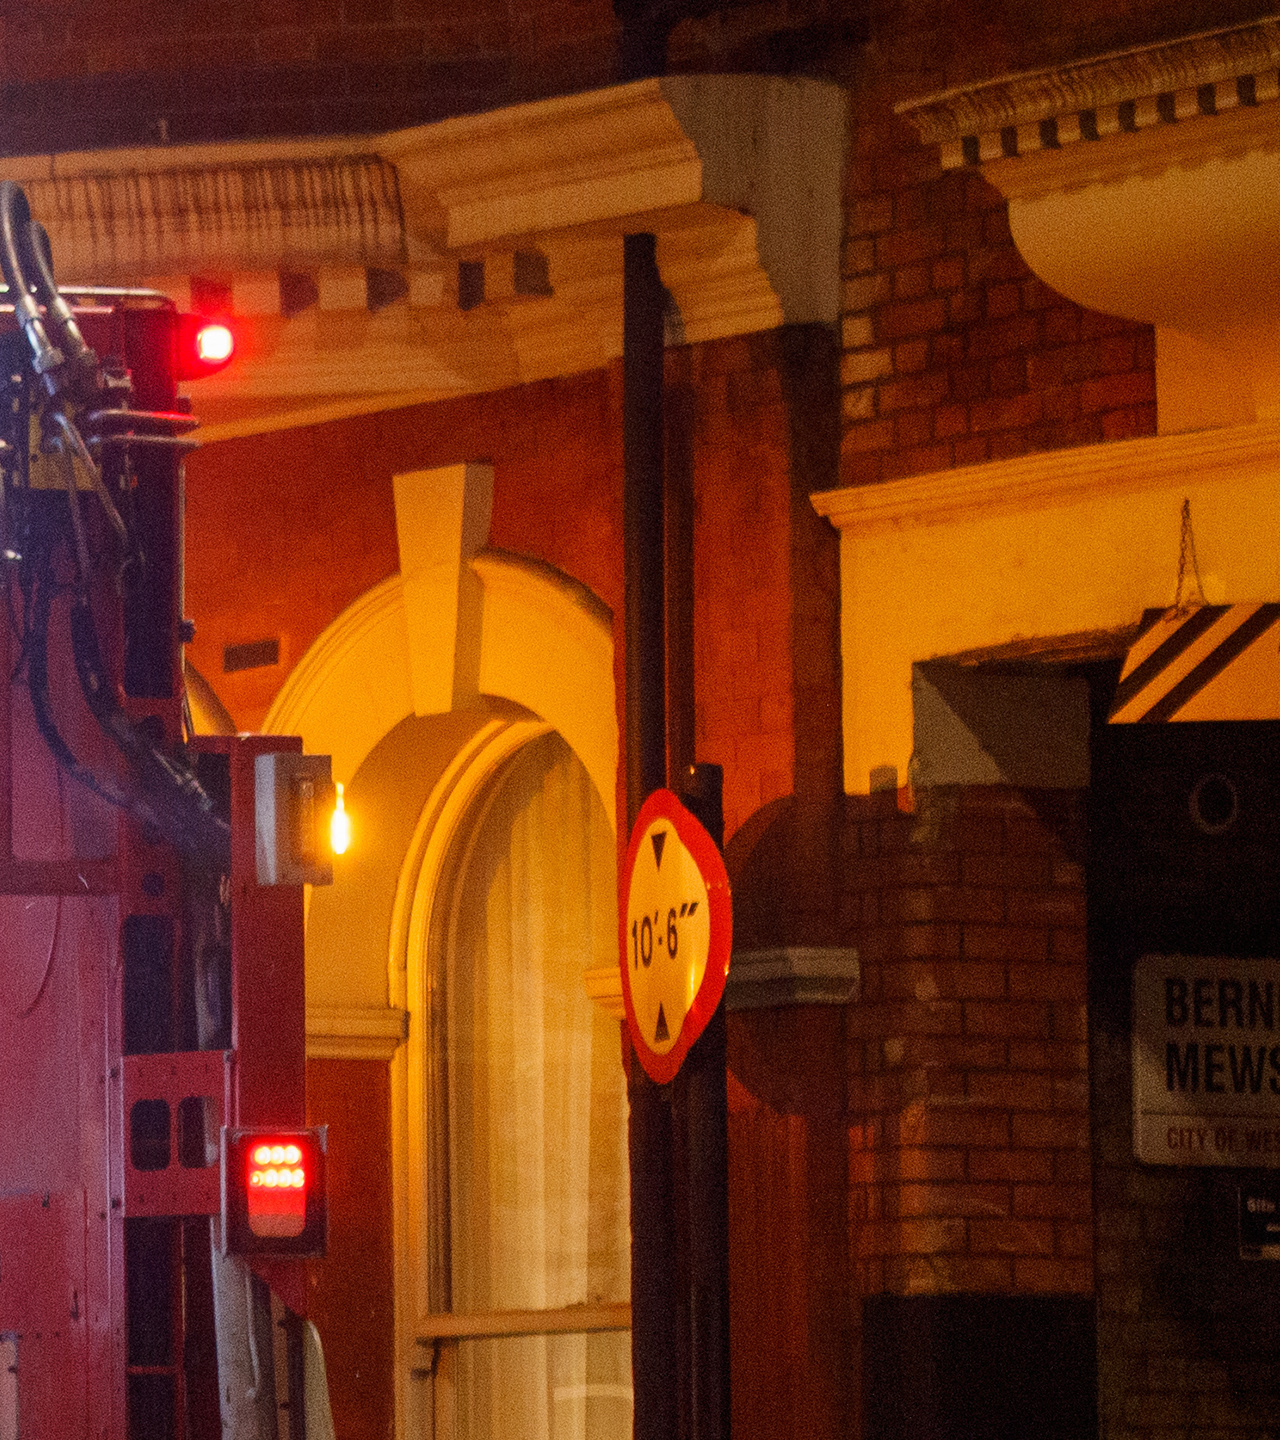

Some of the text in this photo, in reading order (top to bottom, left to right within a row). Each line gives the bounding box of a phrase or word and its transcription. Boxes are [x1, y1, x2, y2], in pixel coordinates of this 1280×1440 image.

[1165, 978, 1280, 1029] BERN
[1166, 1127, 1208, 1151] CITY
[1215, 1127, 1238, 1152] OF
